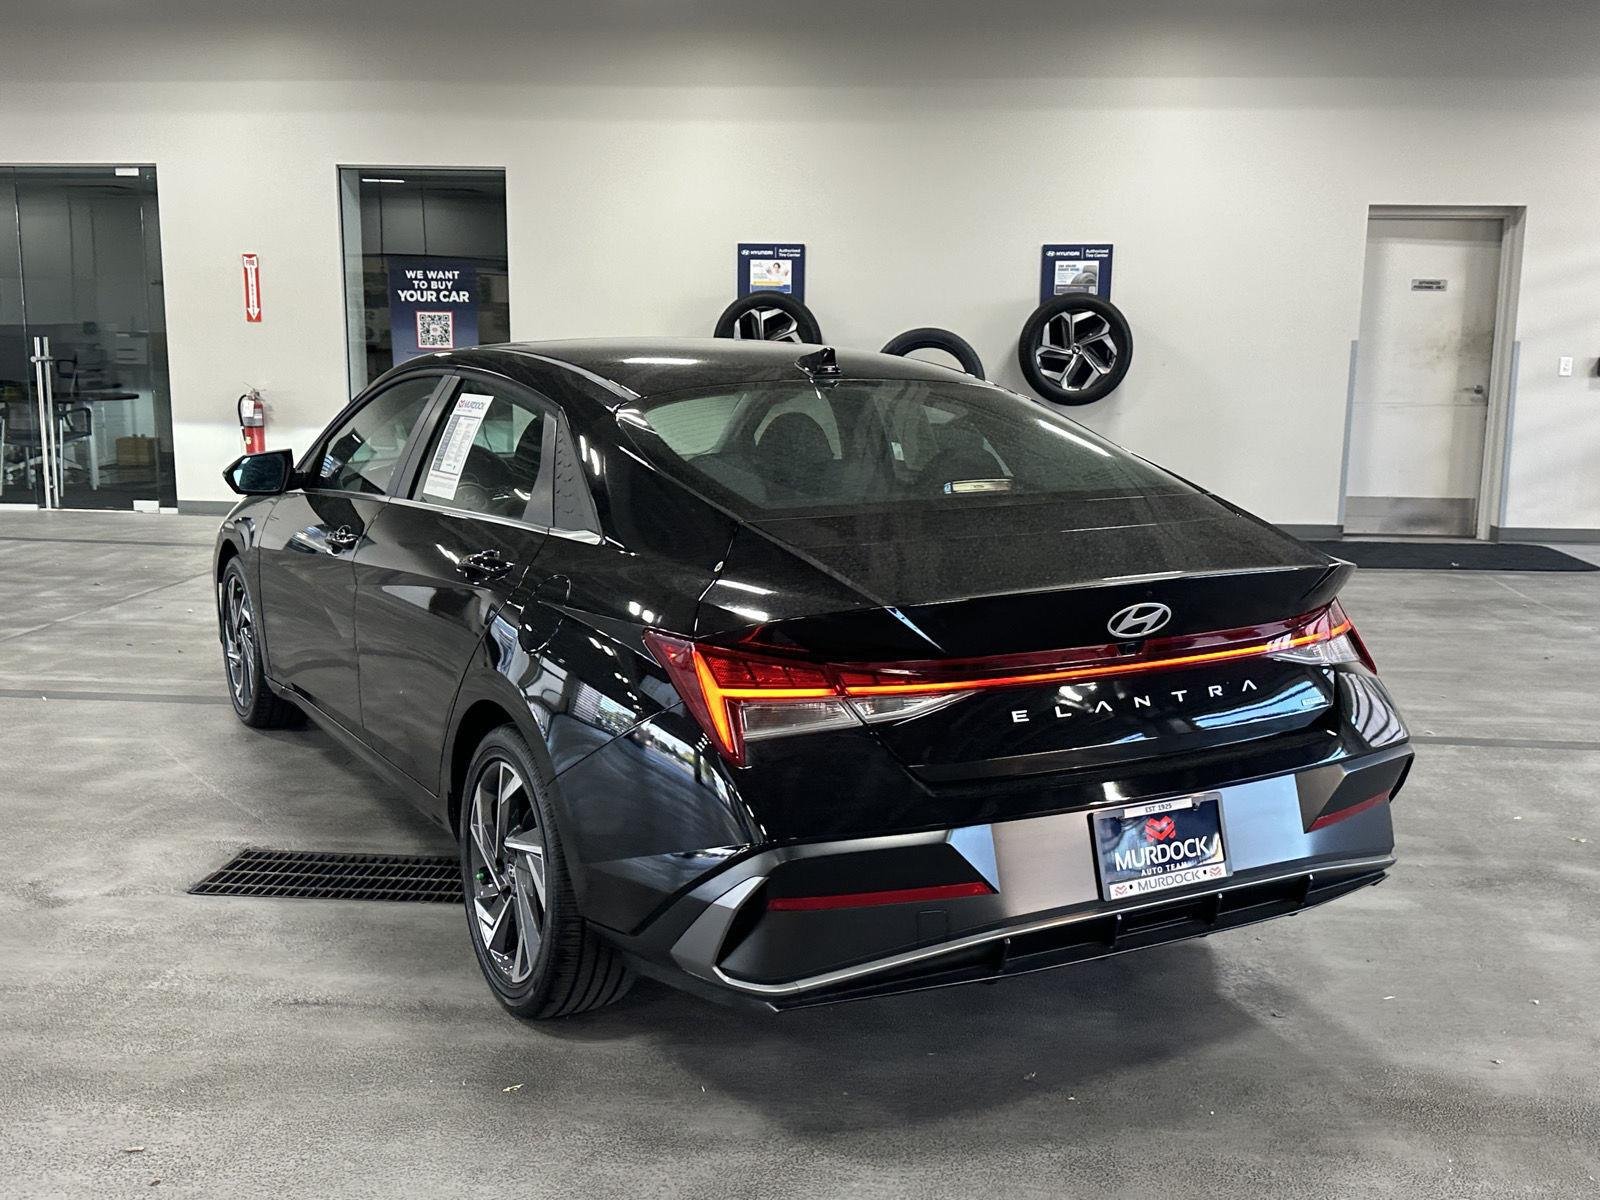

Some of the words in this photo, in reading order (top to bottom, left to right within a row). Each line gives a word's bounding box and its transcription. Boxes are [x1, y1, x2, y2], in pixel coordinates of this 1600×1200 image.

[405, 270, 424, 279] WE
[426, 270, 460, 279] WANT
[412, 280, 428, 289] TO
[430, 281, 454, 289] BUY
[397, 290, 437, 302] YOUR
[439, 291, 470, 303] CAR
[1011, 679, 1258, 723] ELANTRA
[1145, 805, 1156, 813] EST
[1158, 803, 1173, 811] 1925
[1114, 836, 1212, 872] MURDOCK
[1141, 866, 1163, 877] AUTO
[1137, 870, 1200, 892] MURDOCK
